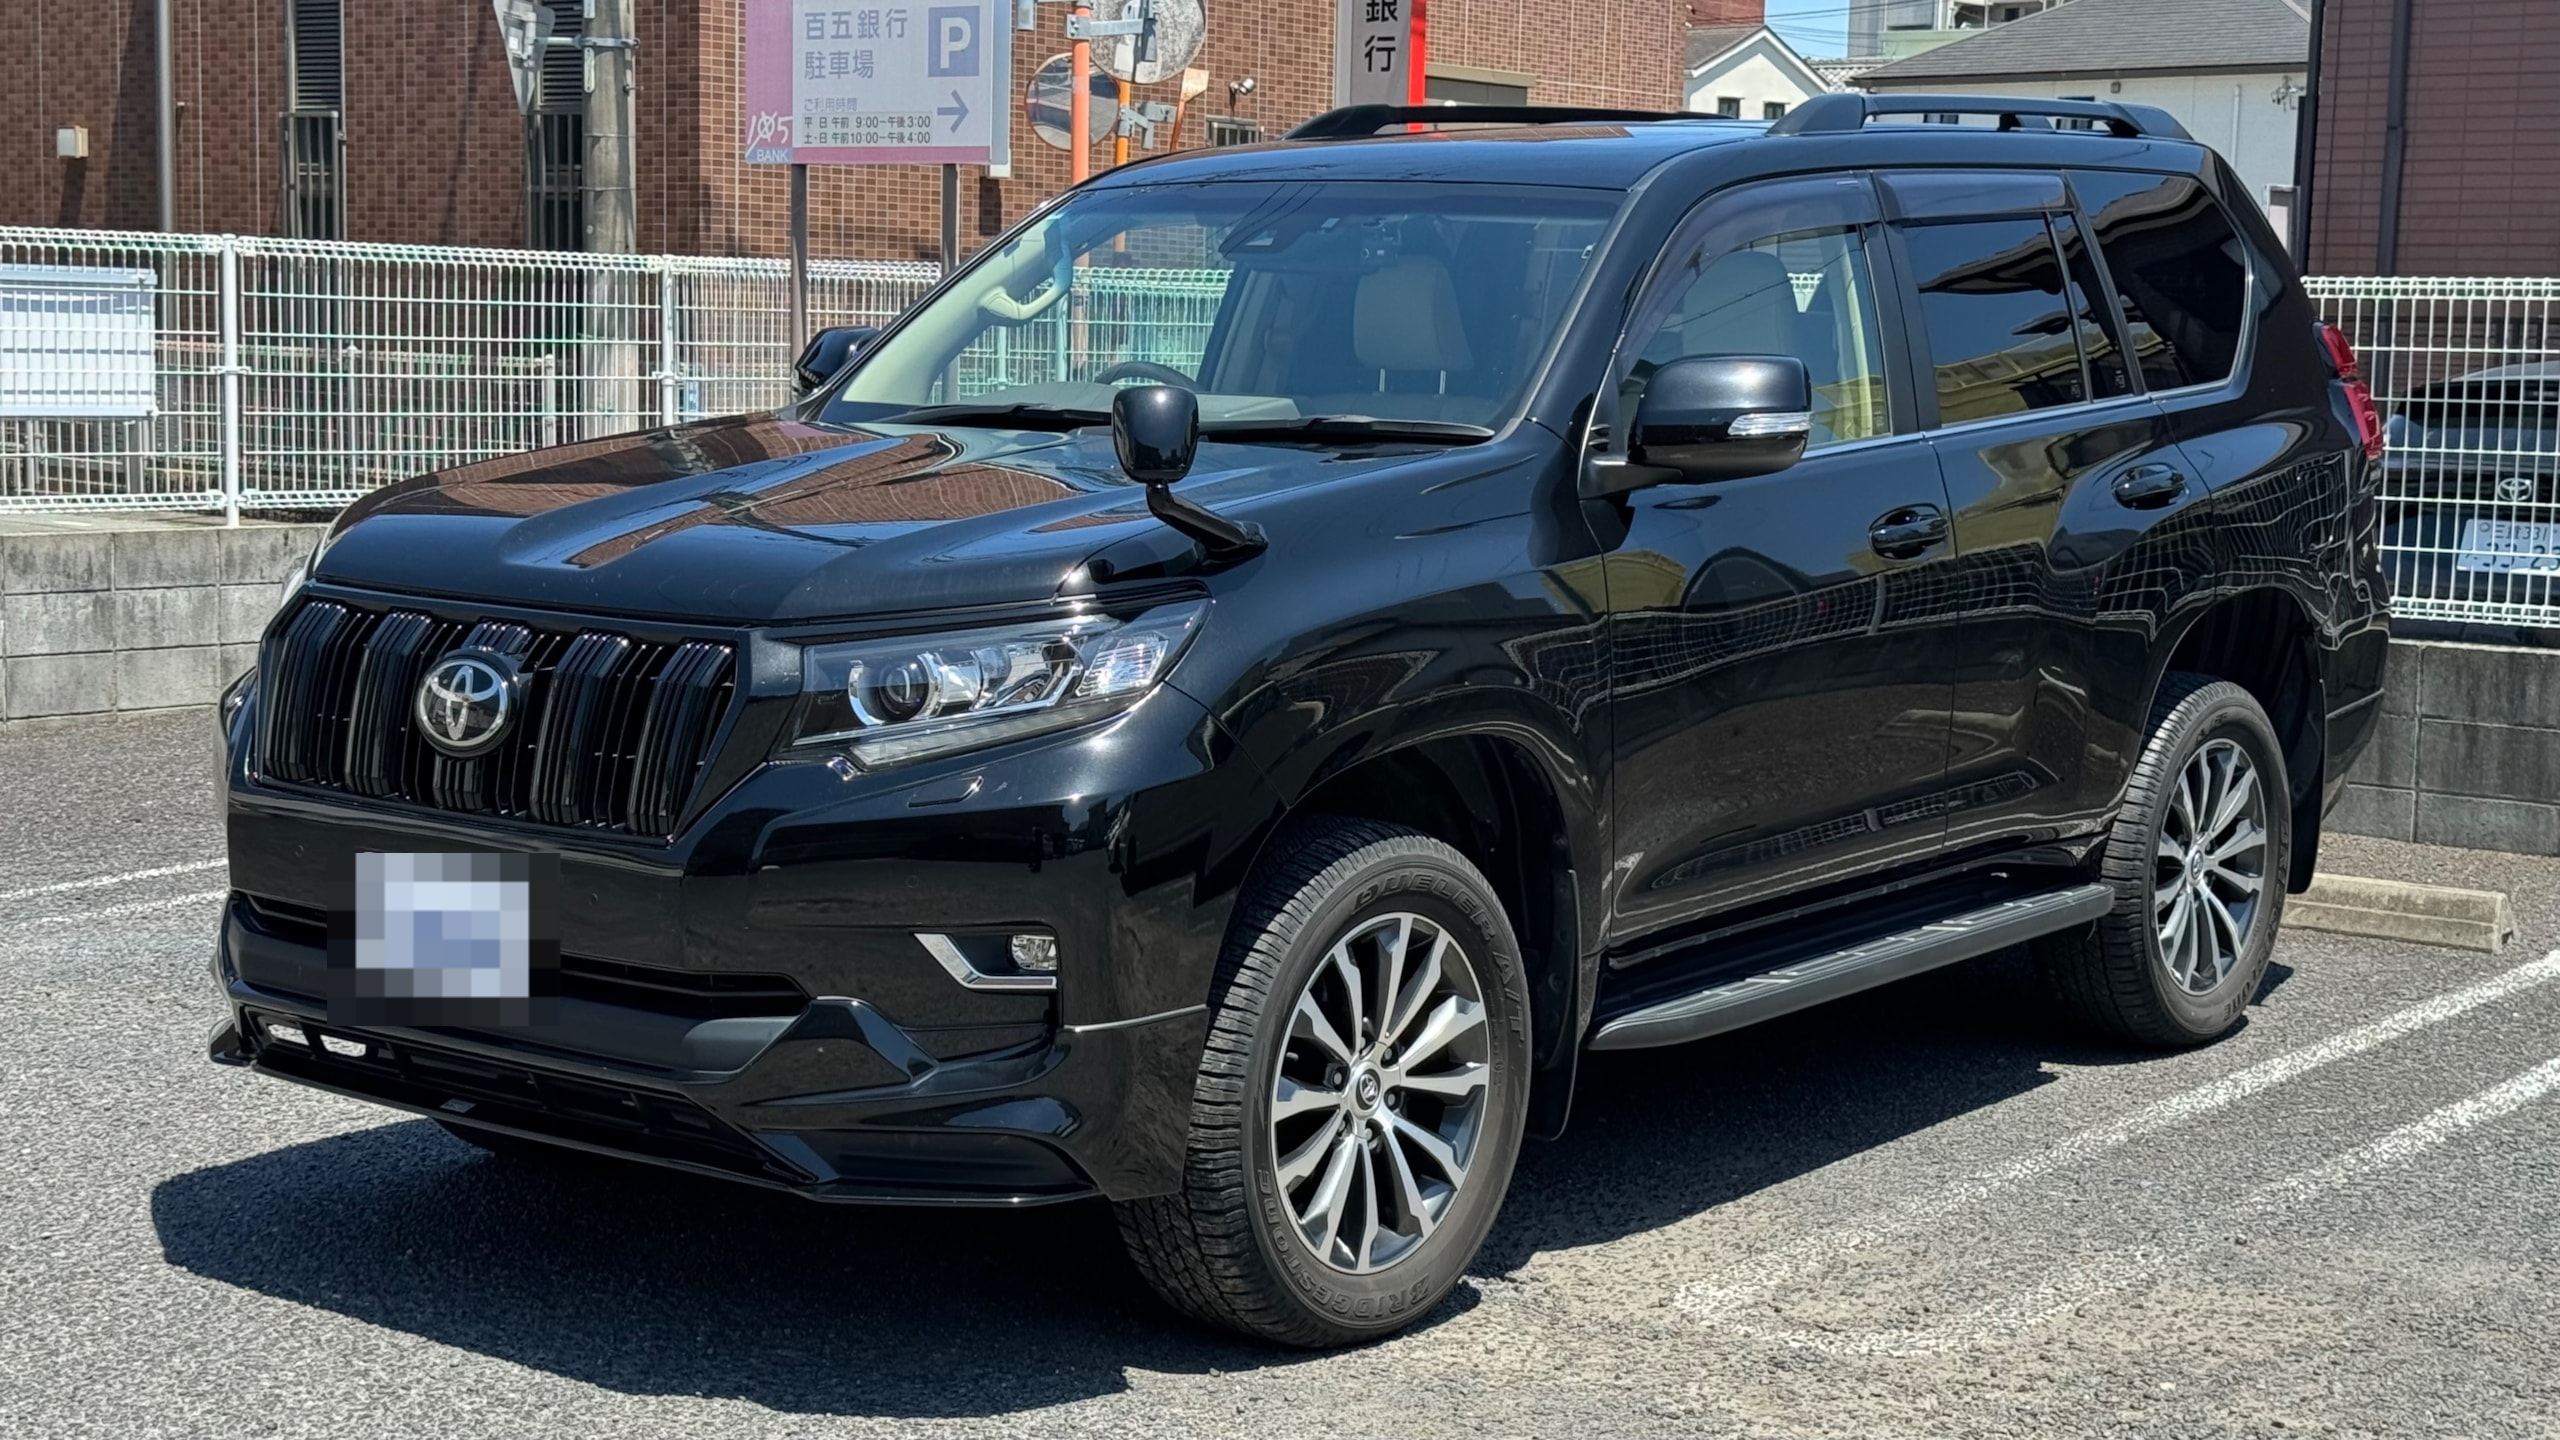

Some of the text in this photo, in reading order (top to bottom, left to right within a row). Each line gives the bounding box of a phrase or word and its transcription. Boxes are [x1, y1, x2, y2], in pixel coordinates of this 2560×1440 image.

[804, 9, 908, 40] 百五銀行
[939, 17, 971, 70] P
[1364, 0, 1398, 73] 銀行
[804, 50, 875, 80] 駐車場
[803, 97, 858, 112] ご利用時間
[756, 148, 789, 162] BANK
[1352, 872, 1497, 942] DUELER
[1257, 1168, 1431, 1318] BRIDGESTONE
